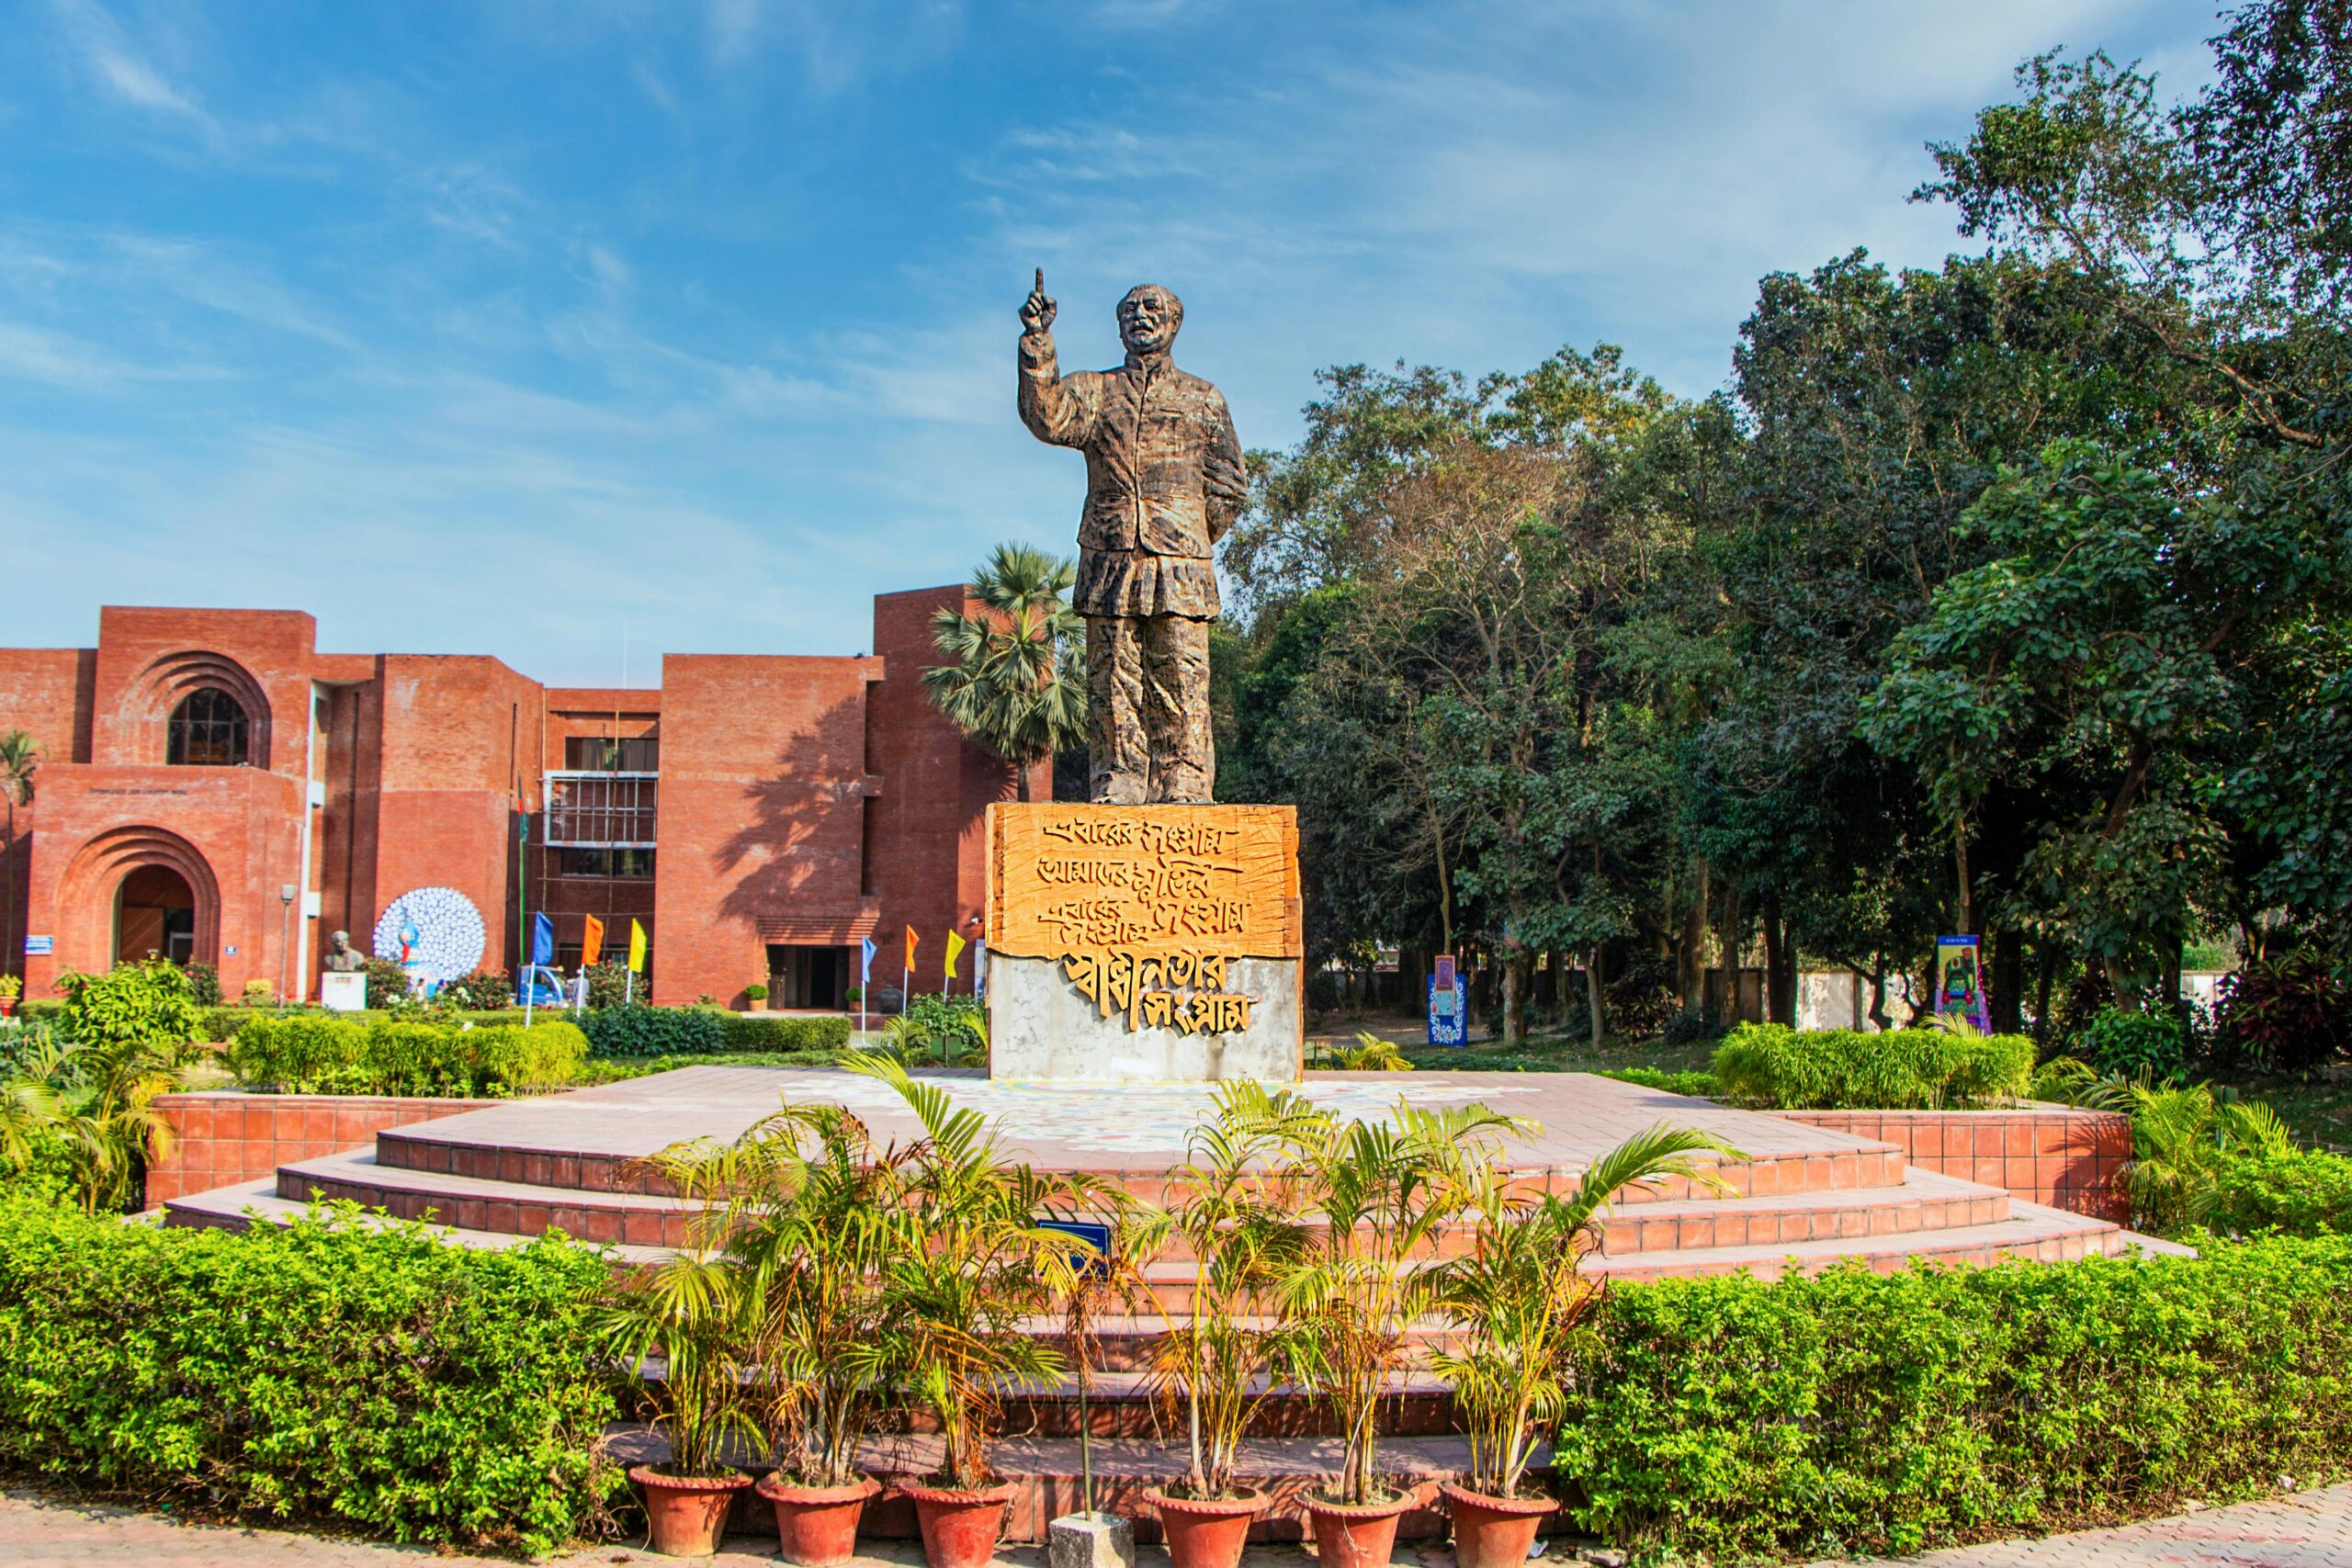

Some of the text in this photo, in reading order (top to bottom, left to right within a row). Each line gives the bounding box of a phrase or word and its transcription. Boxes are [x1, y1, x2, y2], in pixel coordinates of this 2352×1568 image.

[1043, 817, 1240, 856] এবারের সংগ্রাম
[1036, 856, 1244, 908] আমাদের মুক্তির
[1036, 897, 1129, 924] এবারের
[1151, 897, 1252, 936] সংগ্রাম
[1058, 919, 1152, 946] সংগ্রাম
[1062, 945, 1242, 1032] স্বাধীনতার
[1142, 991, 1261, 1036] সংগ্রাম
